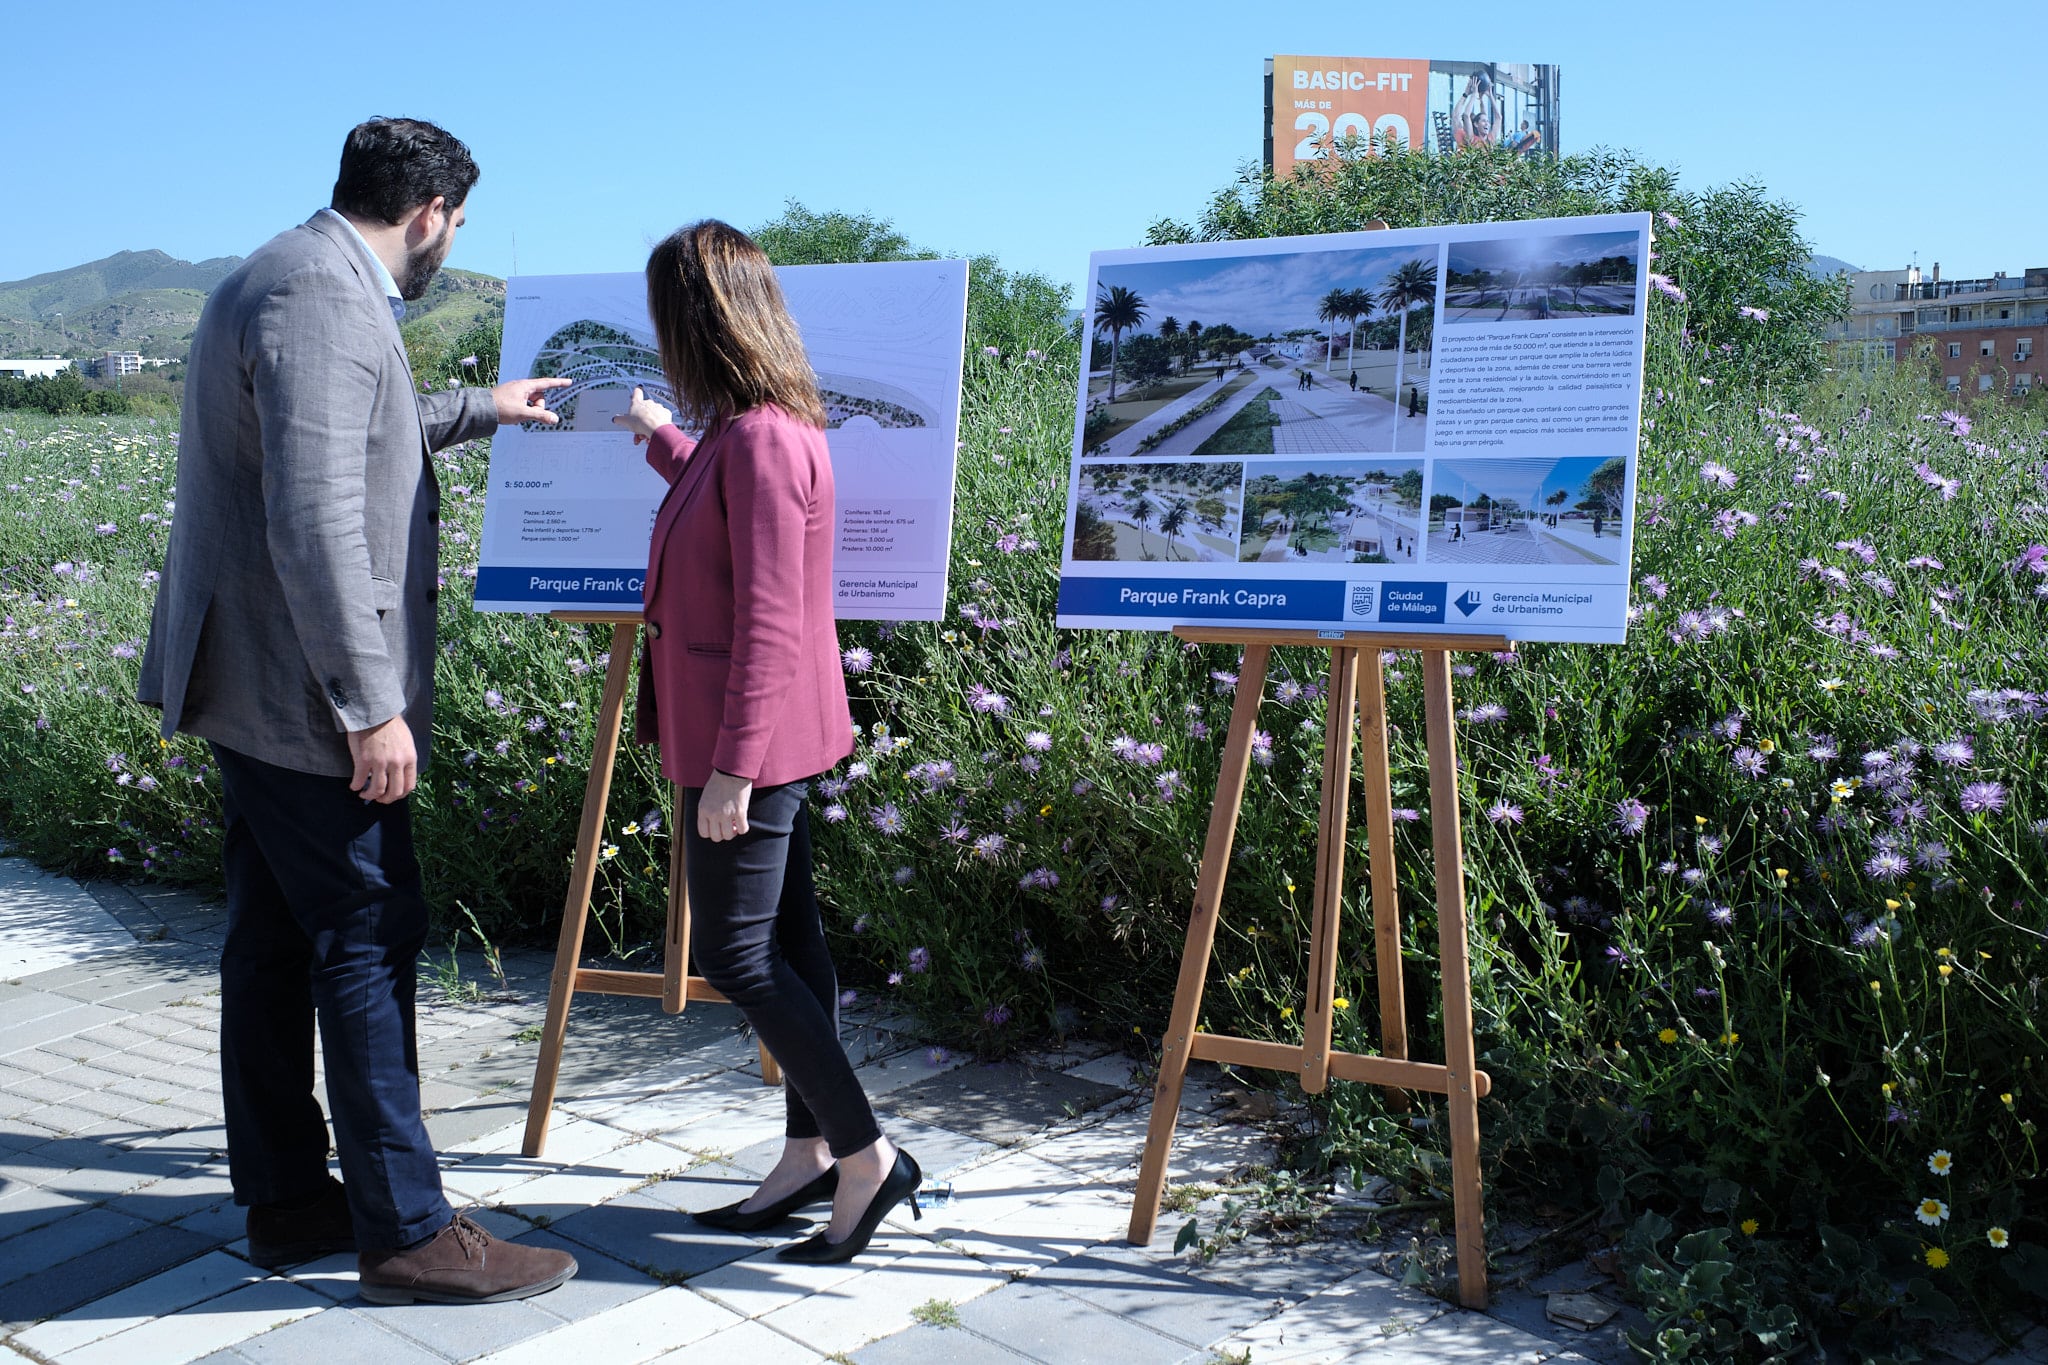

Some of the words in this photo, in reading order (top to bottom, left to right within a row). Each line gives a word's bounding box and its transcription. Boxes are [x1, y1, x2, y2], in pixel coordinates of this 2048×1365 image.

[1293, 70, 1412, 91] BASIC-FIT
[1294, 99, 1315, 108] MÁS
[1294, 112, 1410, 160] 200
[530, 577, 580, 593] Parque
[584, 578, 624, 591] Frank
[878, 581, 918, 590] Municipal
[1120, 588, 1178, 607] Parque
[1182, 589, 1229, 605] Frank
[1234, 590, 1287, 608] Capra
[1389, 591, 1423, 600] Ciudad
[1493, 593, 1539, 602] Gerencia
[1542, 594, 1592, 605] Municipal
[1388, 603, 1400, 611] de
[1402, 603, 1437, 614] Málaga
[1508, 605, 1563, 614] Urbanismo
